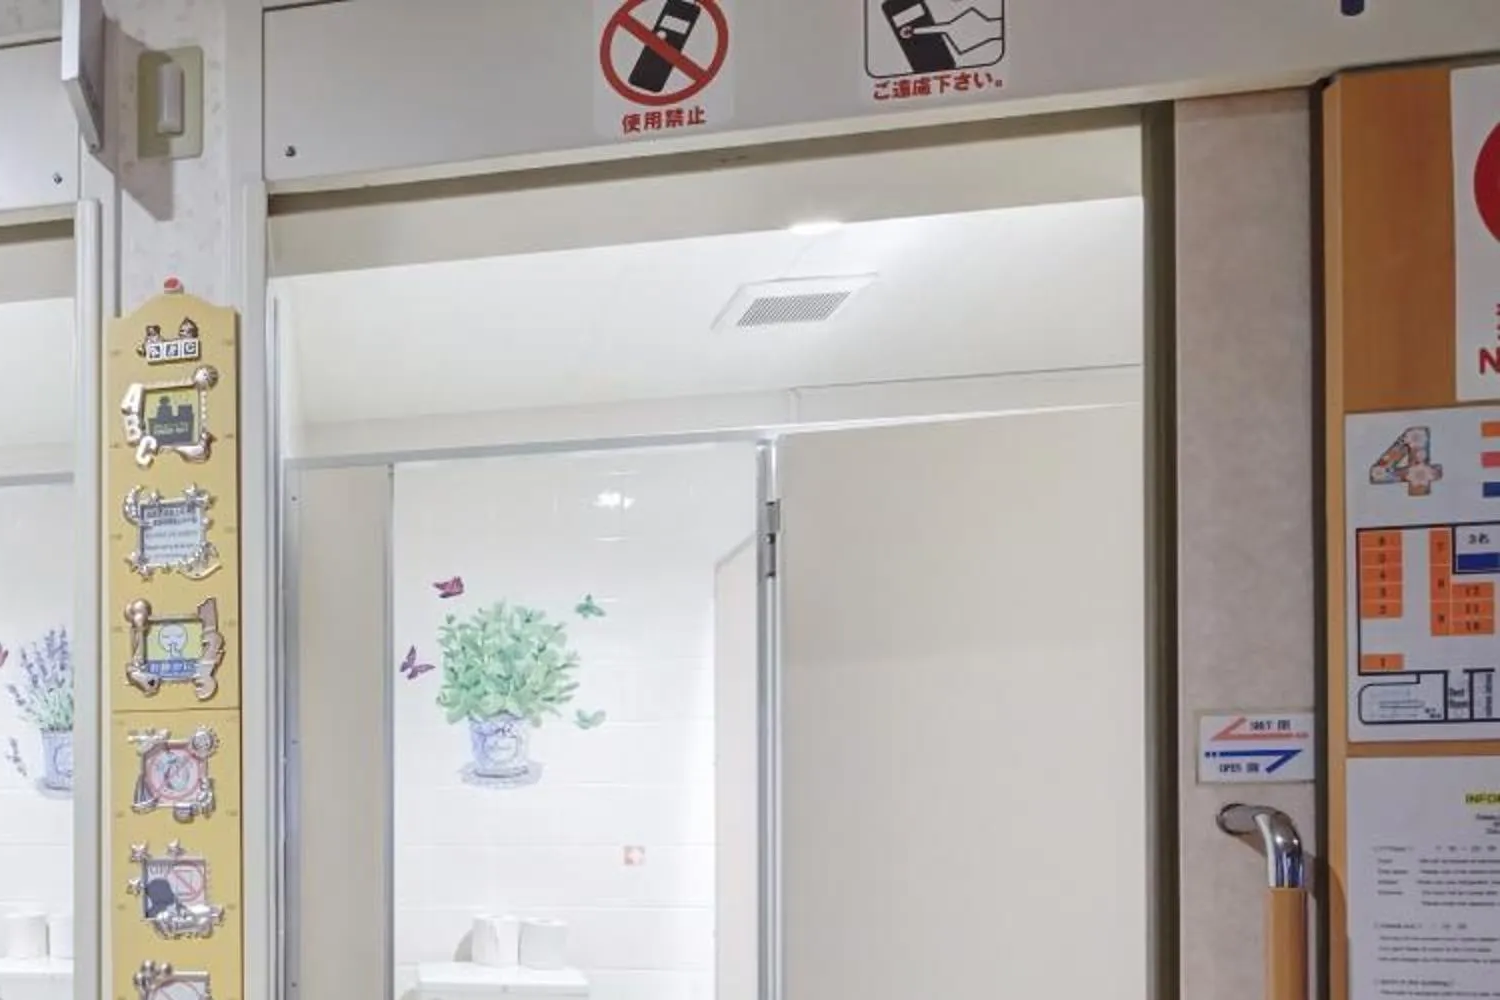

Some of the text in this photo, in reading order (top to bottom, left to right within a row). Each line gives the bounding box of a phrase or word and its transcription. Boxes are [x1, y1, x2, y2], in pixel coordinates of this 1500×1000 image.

[873, 72, 1003, 100] ご遠慮下さい。
[621, 105, 706, 135] 使用禁止
[1369, 426, 1443, 496] 4
